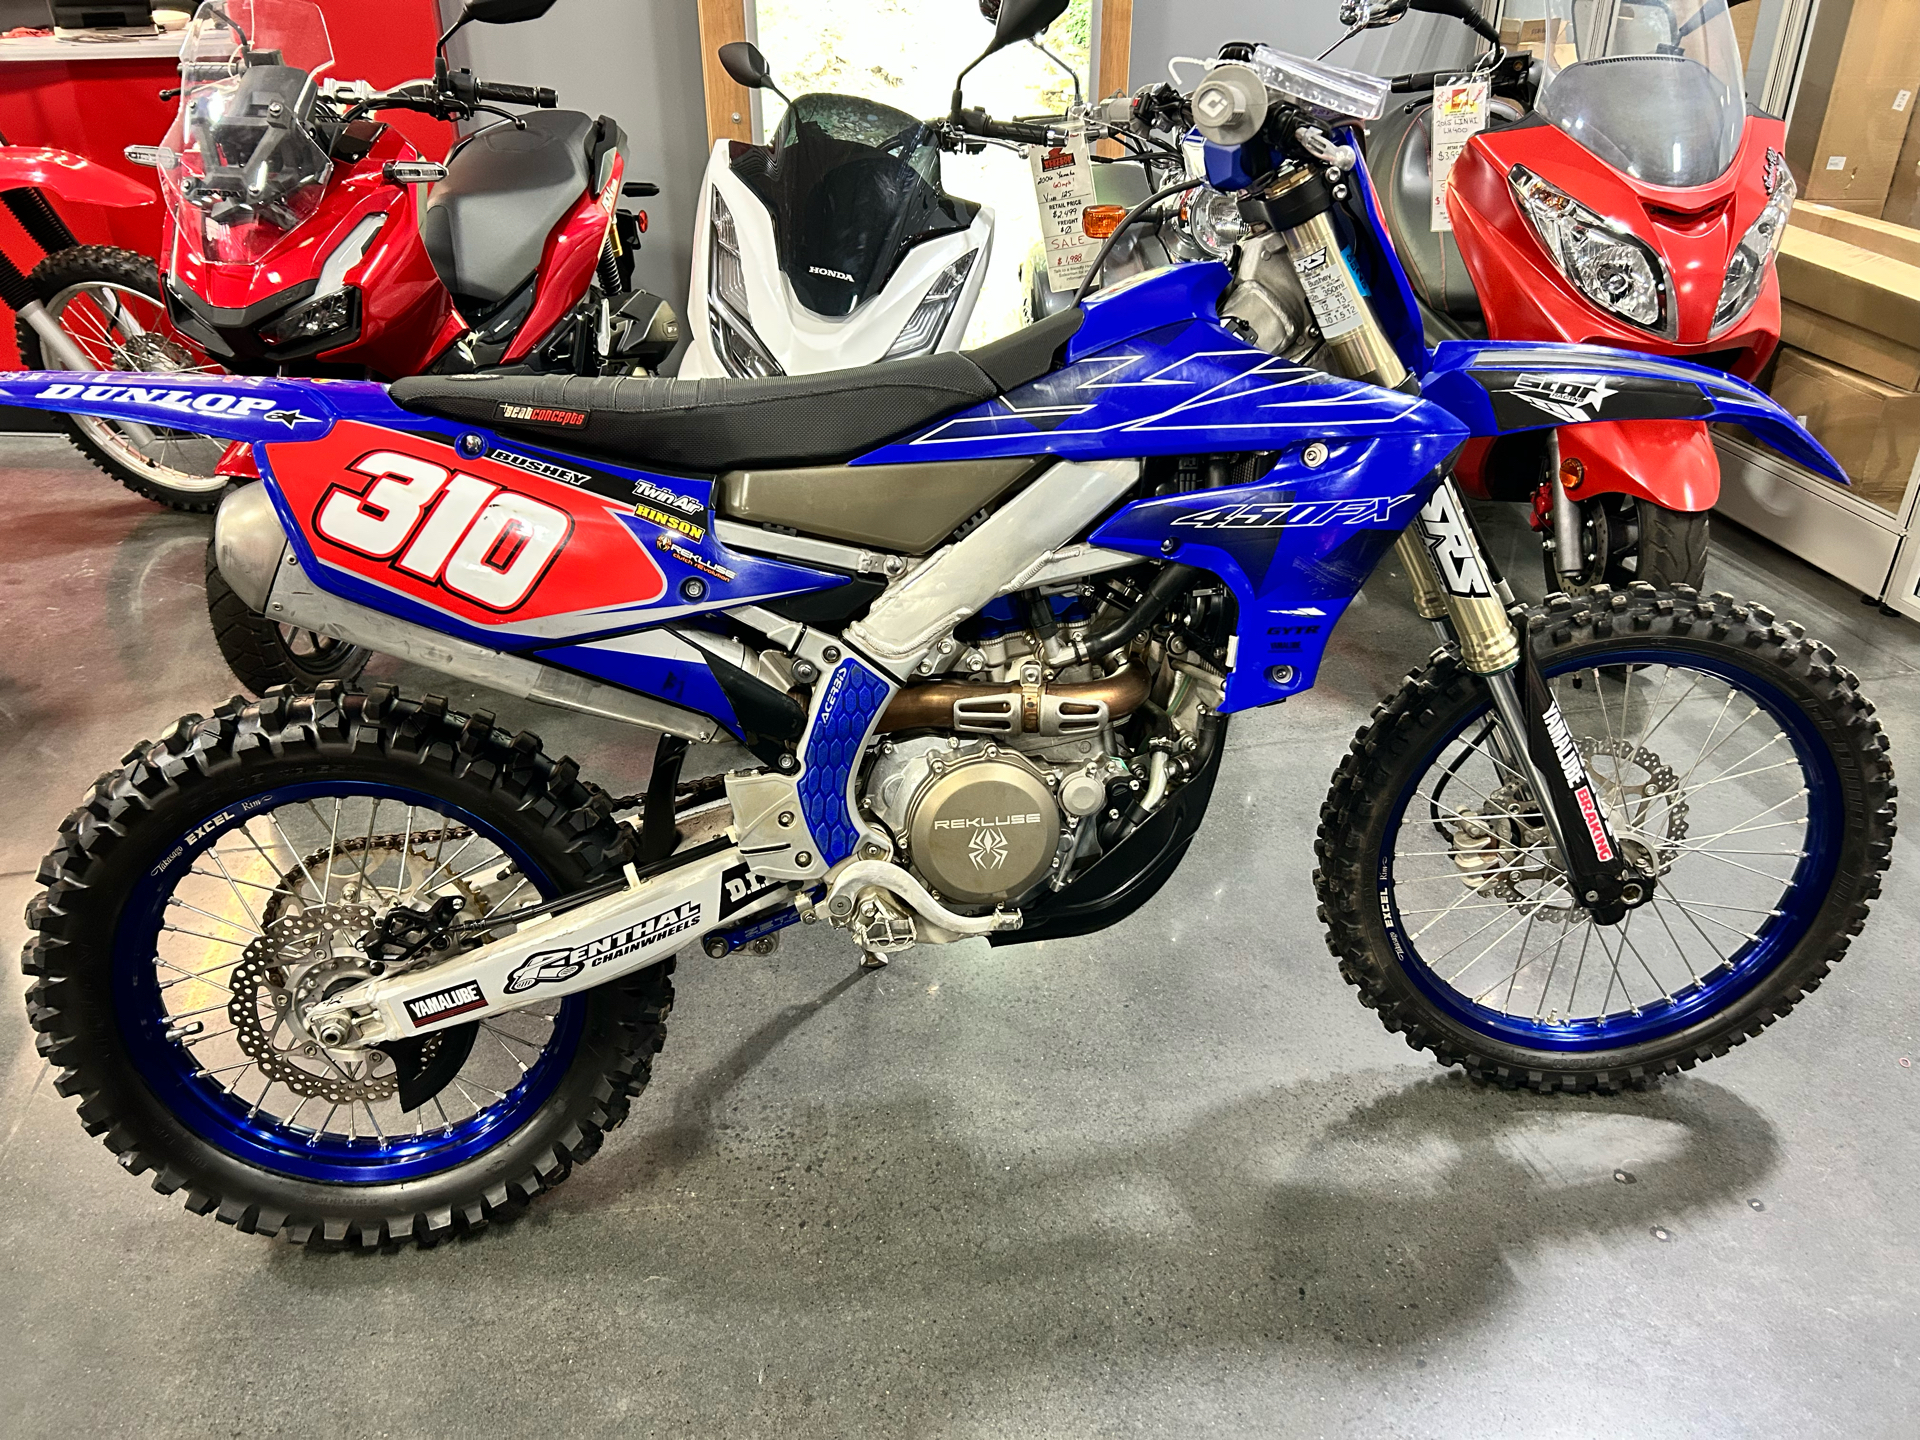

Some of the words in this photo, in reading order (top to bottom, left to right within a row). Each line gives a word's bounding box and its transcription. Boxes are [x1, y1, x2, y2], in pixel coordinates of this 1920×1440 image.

[197, 189, 241, 198] HONDA
[1049, 202, 1065, 210] RETAIL
[1066, 200, 1082, 208] PRICE
[1057, 218, 1078, 226] FREIGHT
[1051, 235, 1085, 249] SALE
[809, 265, 855, 282] HONDA
[1307, 273, 1332, 288] Bushey
[1322, 281, 1345, 297] 350ml
[1321, 303, 1329, 311] 12
[1337, 296, 1346, 305] 13
[1347, 306, 1356, 315] 12
[35, 384, 277, 419] DUNLOP
[1552, 392, 1585, 403] RACING
[491, 450, 591, 486] BUSHEY
[634, 504, 704, 540] HINSON
[1170, 494, 1416, 529] 450FX
[312, 449, 575, 614] 310
[671, 543, 738, 580] REKLUSE
[672, 552, 693, 566] clutch
[1267, 625, 1321, 635] GYTR
[820, 666, 848, 725] ACERBIS
[1541, 700, 1585, 789] YAMALUBE
[151, 846, 184, 876] Takasago
[184, 812, 235, 846] EXCEL
[241, 795, 273, 811] Rim
[934, 813, 1041, 830] REKLUSE
[1575, 786, 1614, 862] BRAKING
[725, 871, 770, 903] D.I.
[1380, 887, 1394, 928] EXCEL
[591, 915, 701, 968] CHAINWHEELS
[409, 983, 481, 1018] YAMALUBE
